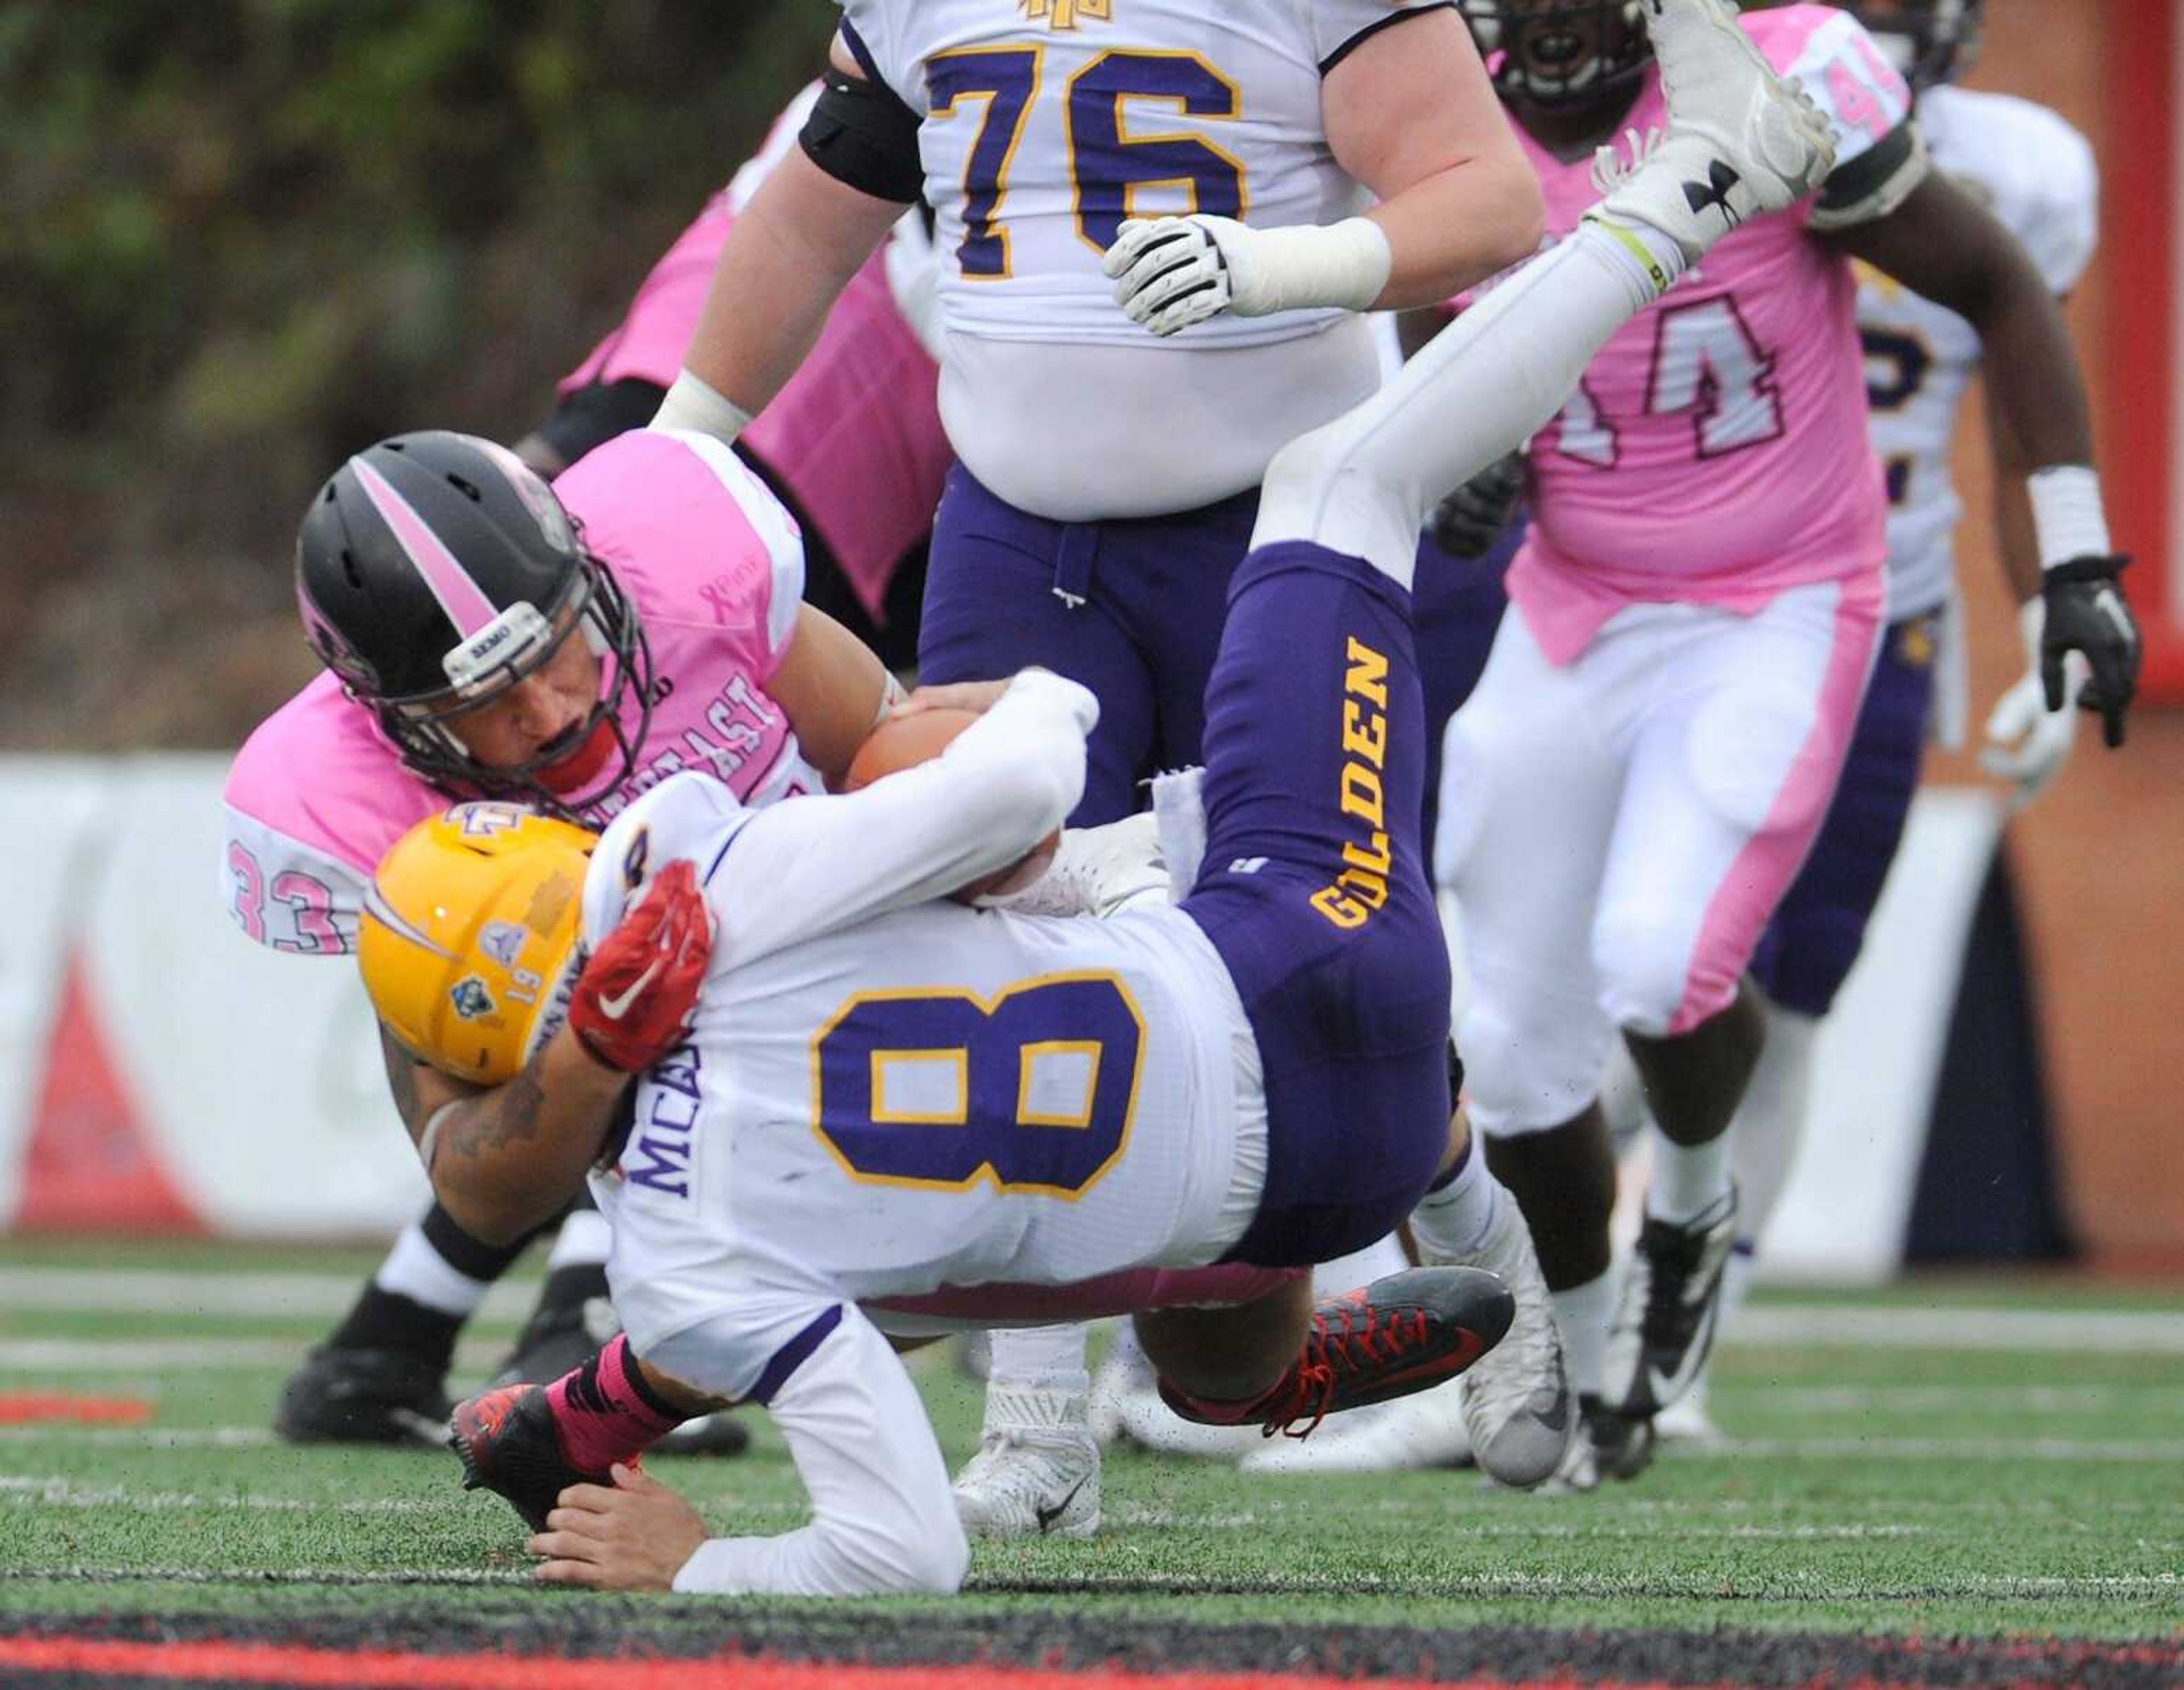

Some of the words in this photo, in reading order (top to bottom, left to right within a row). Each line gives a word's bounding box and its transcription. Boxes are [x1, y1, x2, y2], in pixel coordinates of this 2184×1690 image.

[925, 43, 1249, 279] 76
[471, 626, 510, 659] SEMO
[228, 838, 348, 956] 33
[1310, 636, 1389, 929] GOLDEN
[811, 969, 1148, 1203] 8
